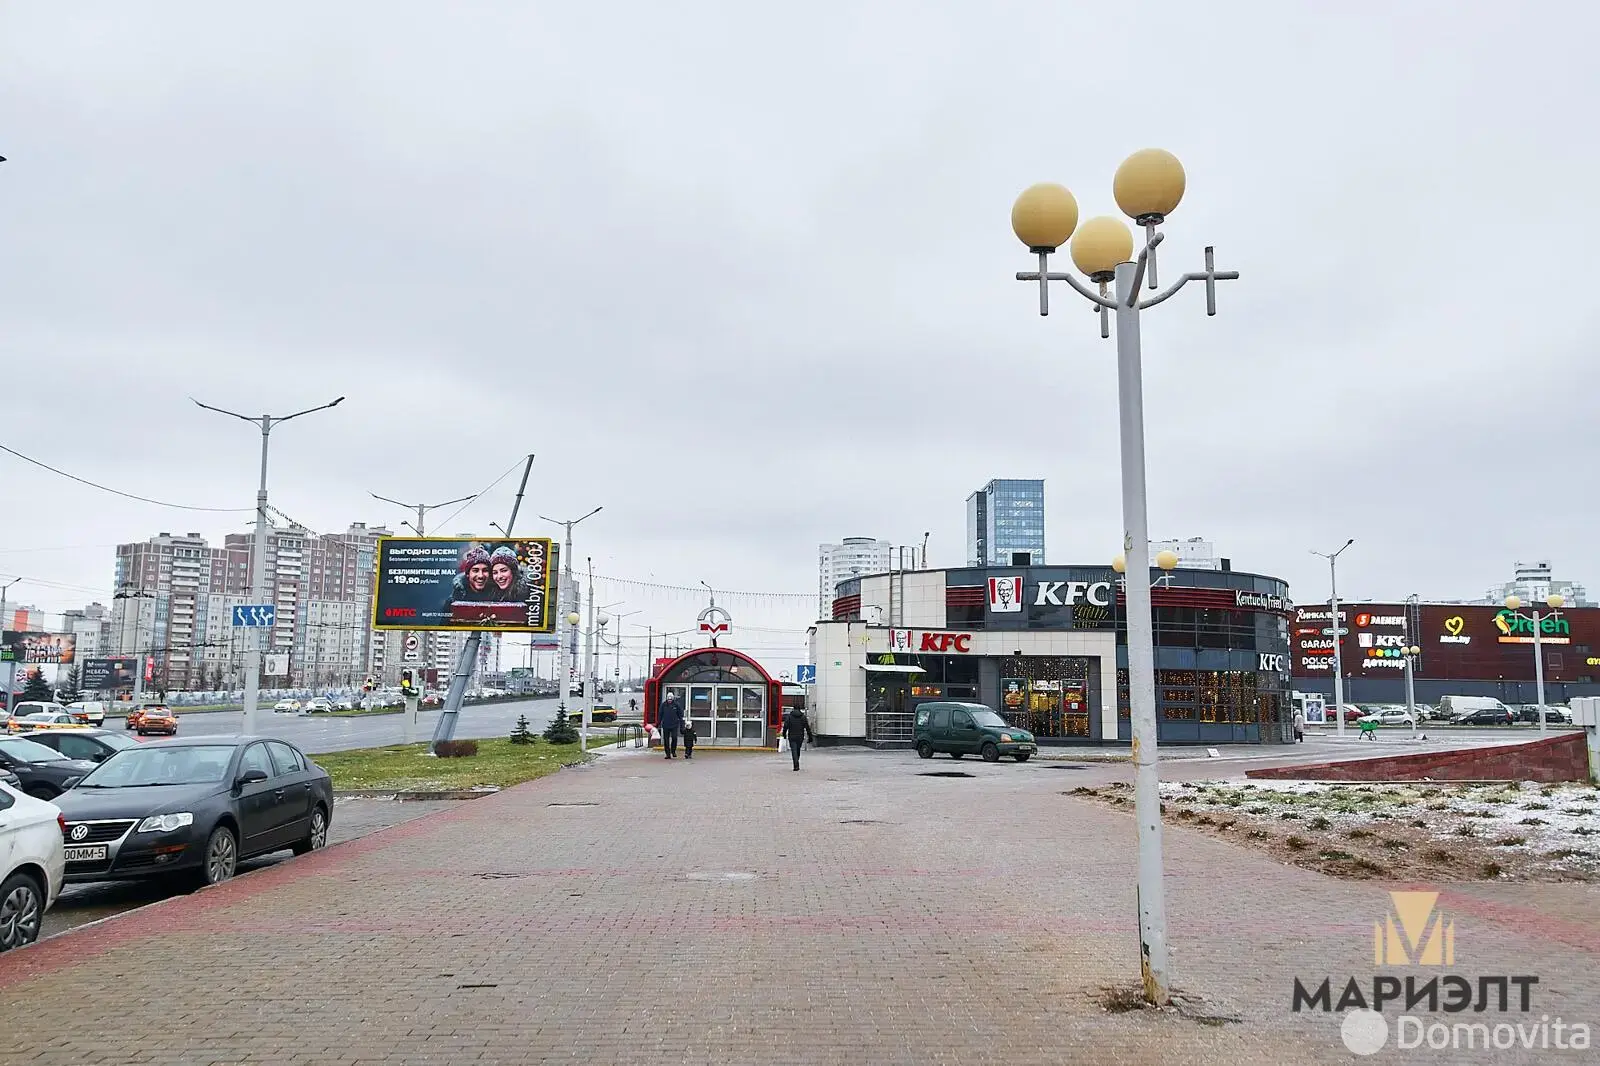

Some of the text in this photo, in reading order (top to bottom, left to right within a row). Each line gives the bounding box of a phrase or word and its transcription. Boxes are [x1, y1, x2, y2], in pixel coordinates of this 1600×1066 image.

[394, 575, 420, 584] 19,90
[1034, 581, 1110, 606] KFC
[1235, 589, 1267, 610] Kentucky
[525, 583, 544, 626] mts.by/
[393, 608, 416, 617] МТС
[1296, 609, 1346, 622] ХИНКАЛЬЯ
[1370, 616, 1406, 625] ЭЛЕМЕНТ
[1496, 610, 1569, 634] Green
[920, 632, 971, 652] KFC
[1301, 640, 1335, 648] GARAG
[1375, 635, 1405, 646] KFC
[1259, 653, 1283, 671] KFC
[64, 848, 104, 859] 00MM-5
